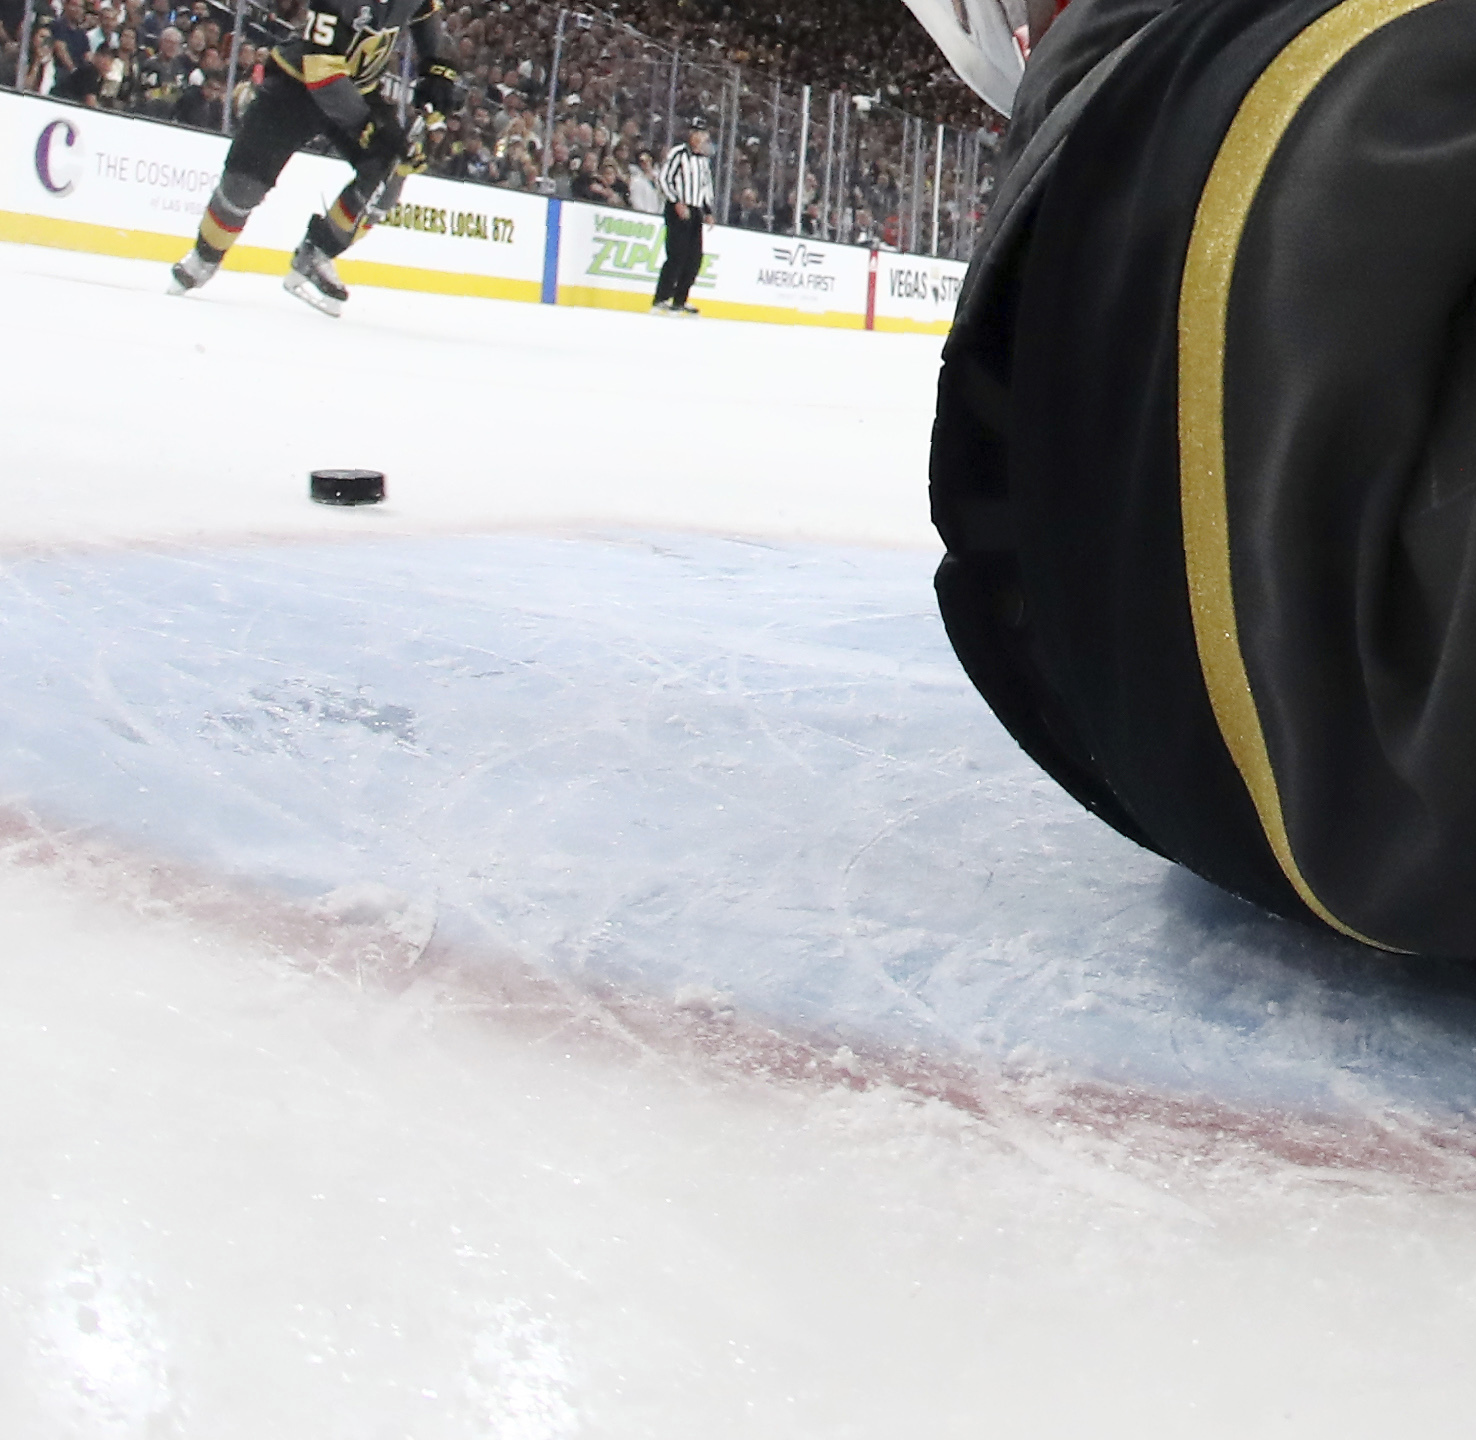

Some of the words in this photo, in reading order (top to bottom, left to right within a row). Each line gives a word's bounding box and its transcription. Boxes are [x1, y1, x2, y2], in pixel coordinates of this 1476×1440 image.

[303, 10, 337, 46] 75
[96, 152, 129, 181] THE
[380, 203, 446, 235] ABORERS
[451, 211, 487, 239] LOCAL
[493, 217, 514, 243] 872
[586, 224, 720, 280] ZIPLE
[757, 269, 804, 289] AMERICA
[807, 273, 835, 292] FIRST
[890, 269, 928, 300] VEGAS
